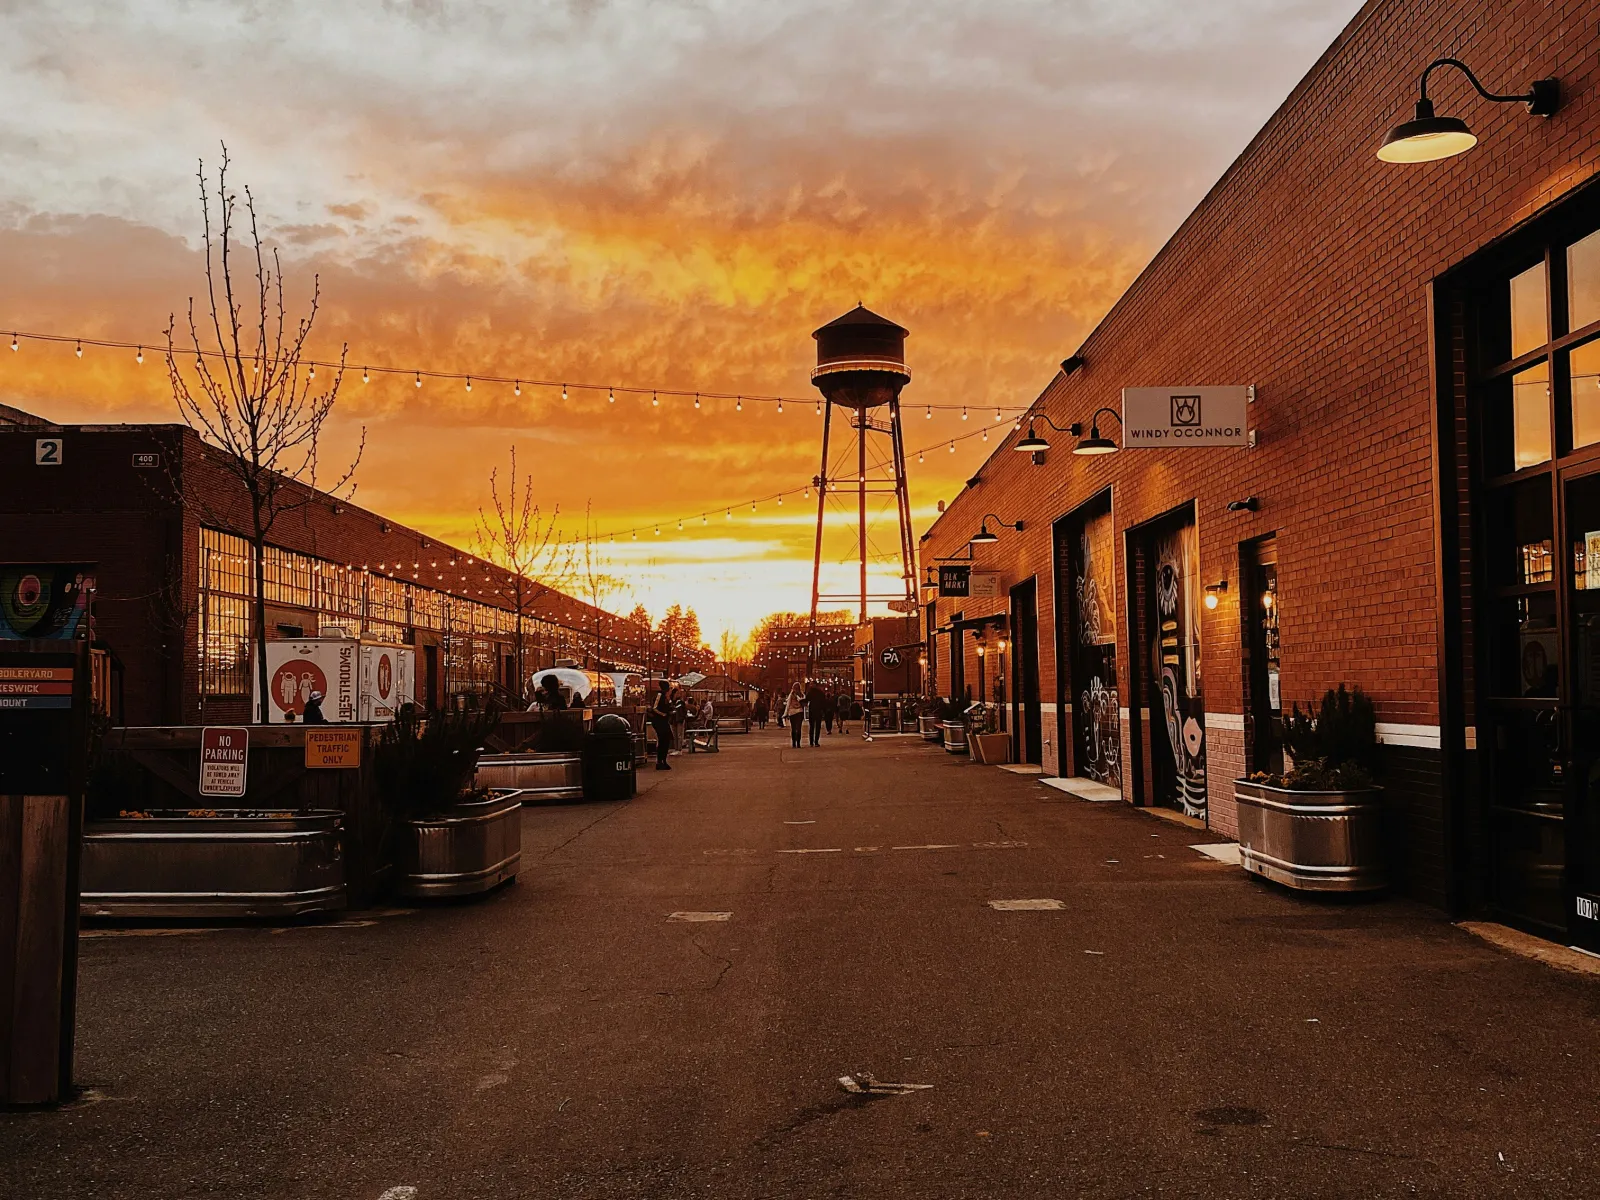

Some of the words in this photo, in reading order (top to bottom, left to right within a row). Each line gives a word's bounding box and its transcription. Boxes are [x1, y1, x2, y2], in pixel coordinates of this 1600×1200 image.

[1131, 429, 1170, 438] WINDY
[1174, 427, 1241, 438] OCONNOR
[40, 441, 58, 462] 2
[138, 455, 153, 463] 400
[943, 572, 958, 581] BLK
[945, 580, 967, 589] MRKT
[884, 652, 899, 664] PA
[339, 647, 352, 720] RESTROOMS
[218, 735, 231, 747] NO
[309, 733, 357, 742] PEDESTRIAN
[317, 744, 349, 753] TRAFFIC
[205, 748, 244, 761] PARKING
[322, 755, 343, 764] ONLY
